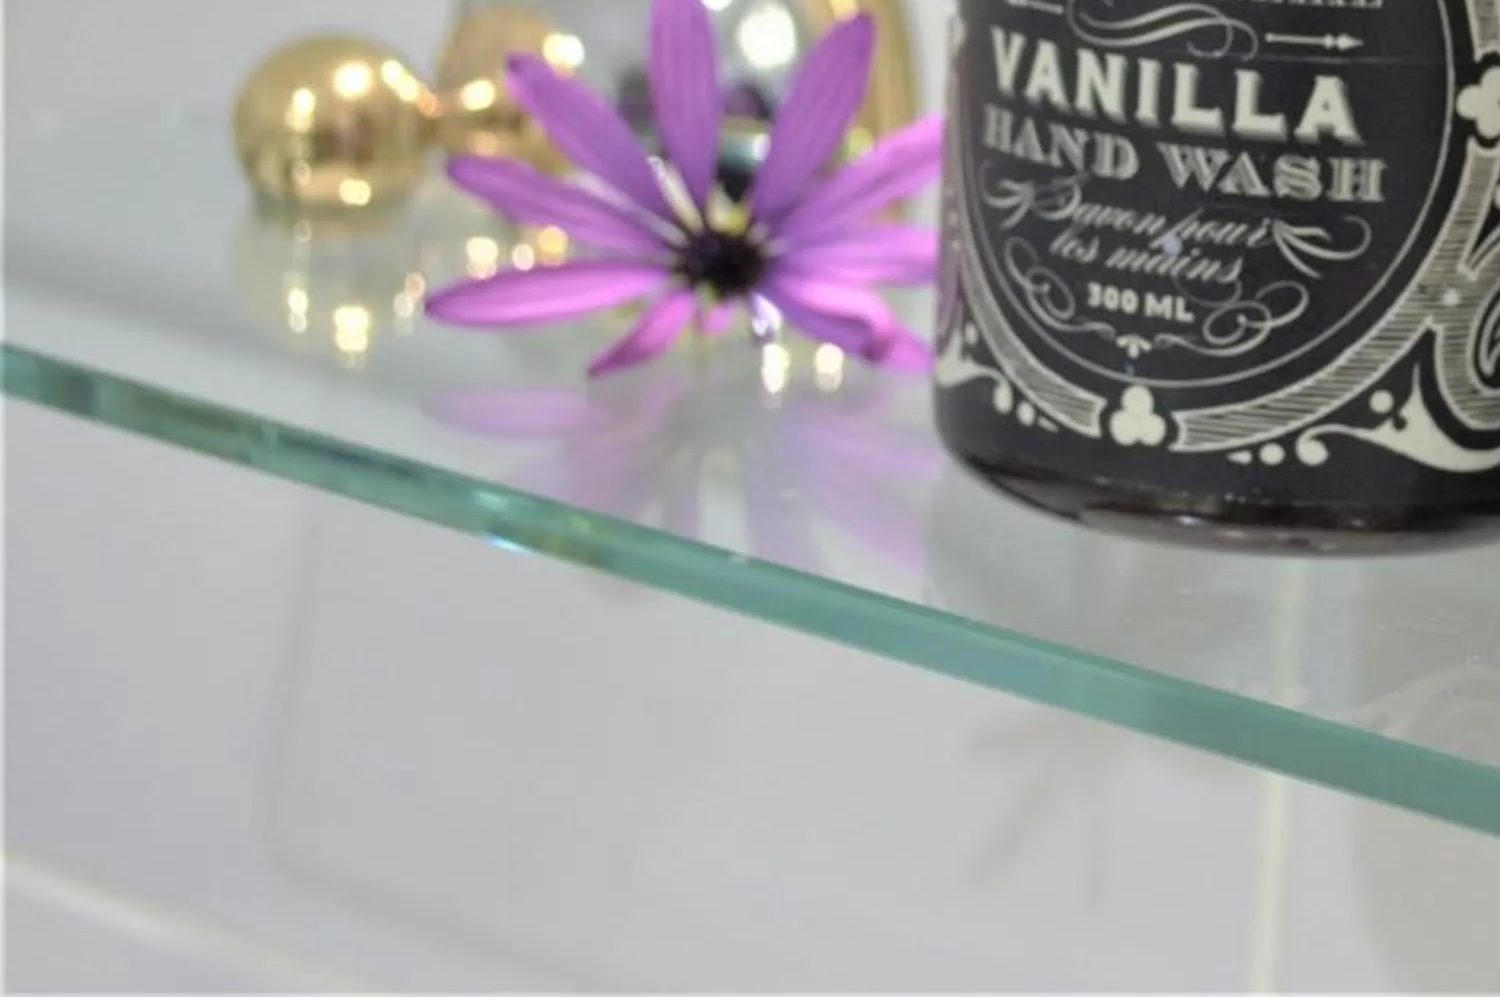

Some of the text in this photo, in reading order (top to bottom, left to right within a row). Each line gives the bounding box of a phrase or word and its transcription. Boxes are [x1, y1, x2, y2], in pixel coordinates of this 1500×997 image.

[989, 25, 1364, 145] VANILLA
[984, 104, 1387, 202] HAND WASH
[1086, 281, 1196, 324] 300 ML
